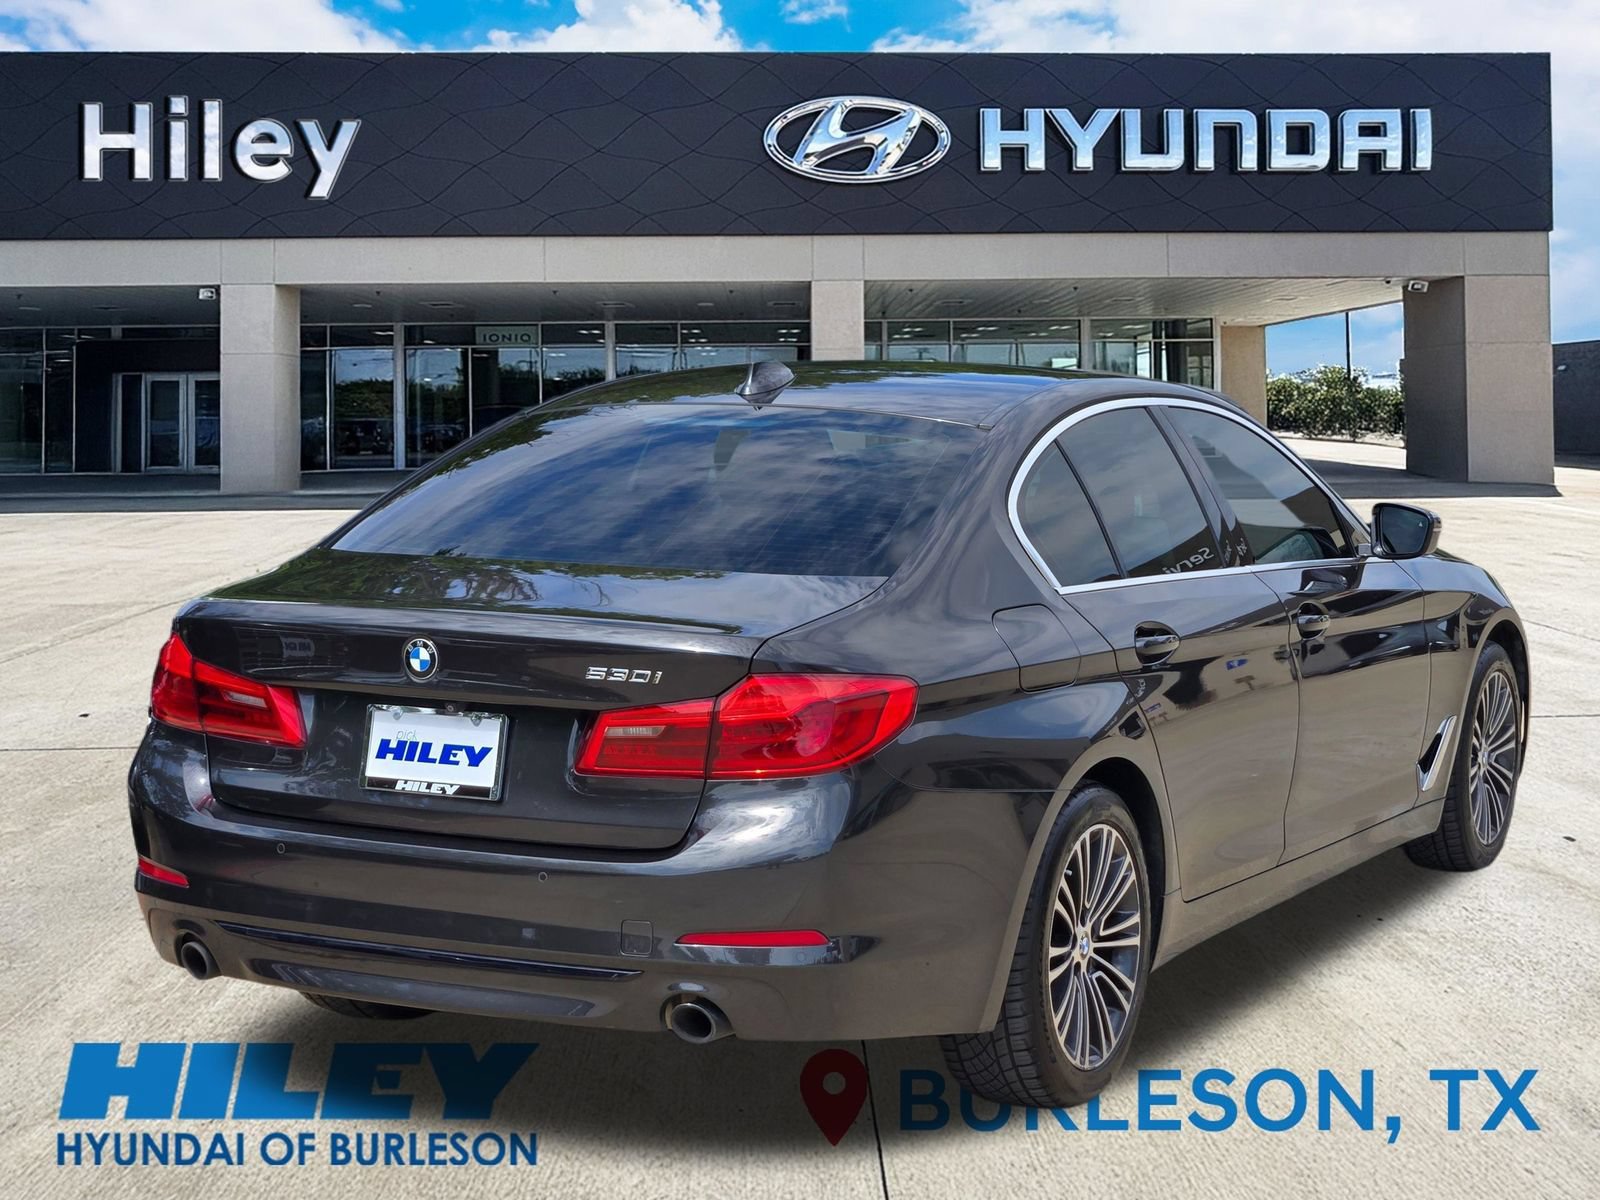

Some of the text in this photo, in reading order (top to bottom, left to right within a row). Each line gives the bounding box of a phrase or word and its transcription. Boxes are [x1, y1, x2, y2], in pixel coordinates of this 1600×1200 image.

[80, 95, 361, 200] Hiley
[979, 107, 1433, 172] HYUNDAI
[585, 666, 663, 685] 530i
[375, 738, 493, 768] HILEY
[394, 780, 461, 795] HILEY
